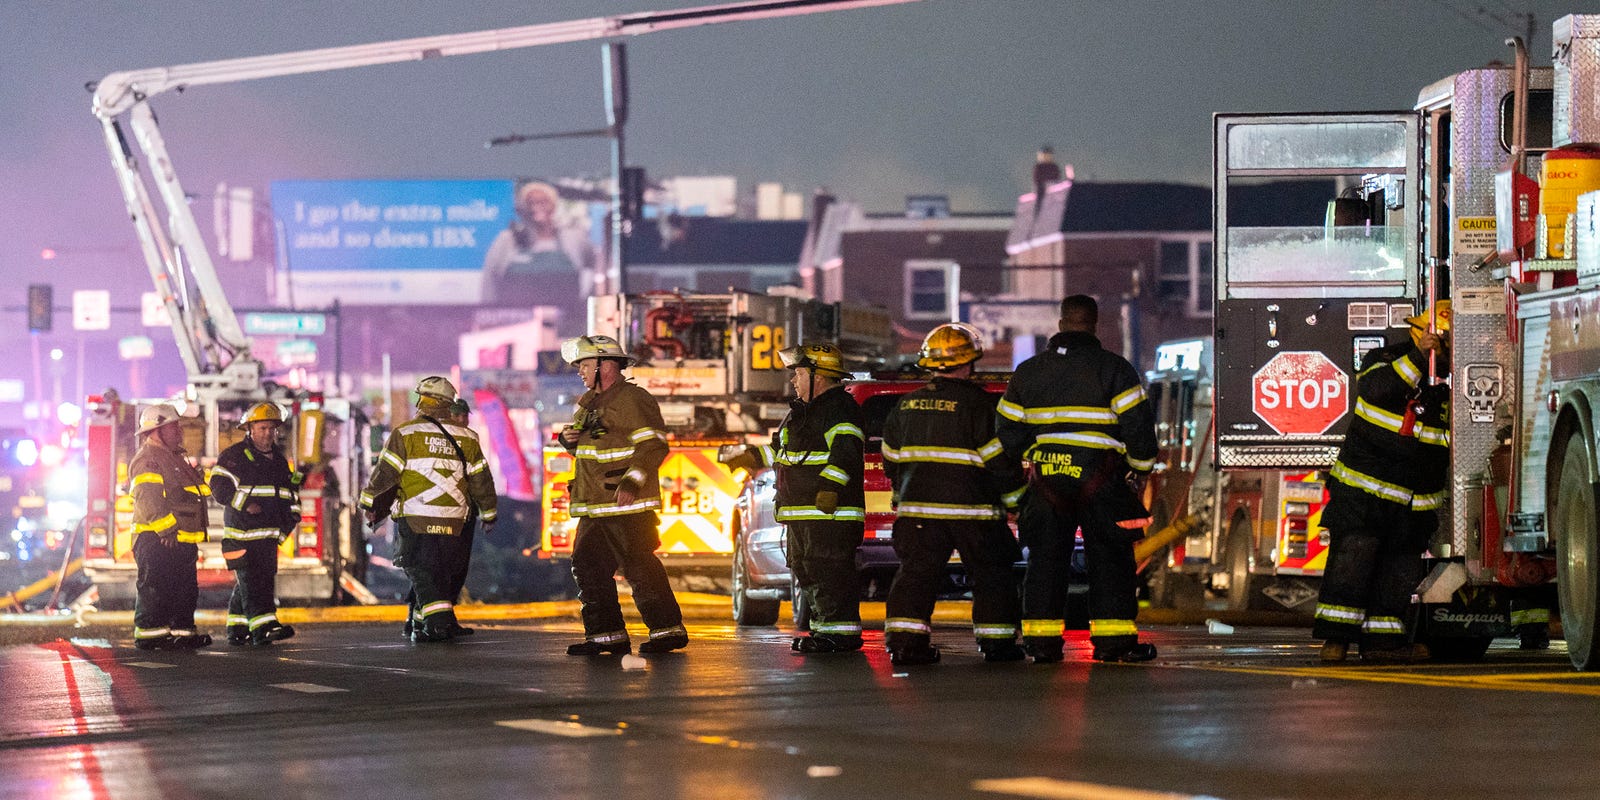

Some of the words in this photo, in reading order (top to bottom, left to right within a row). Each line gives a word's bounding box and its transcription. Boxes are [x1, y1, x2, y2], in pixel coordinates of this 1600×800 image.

[294, 202, 304, 223] I
[308, 206, 339, 228] go
[341, 201, 380, 222] the
[383, 205, 443, 222] extra
[447, 200, 499, 222] mile
[1462, 220, 1497, 230] CAUTIO
[294, 225, 340, 248] and
[344, 232, 371, 248] so
[373, 227, 429, 248] does
[432, 227, 476, 248] IBX
[752, 325, 785, 370] 28
[1260, 379, 1341, 409] STOP
[1432, 607, 1506, 629] Seagrave
